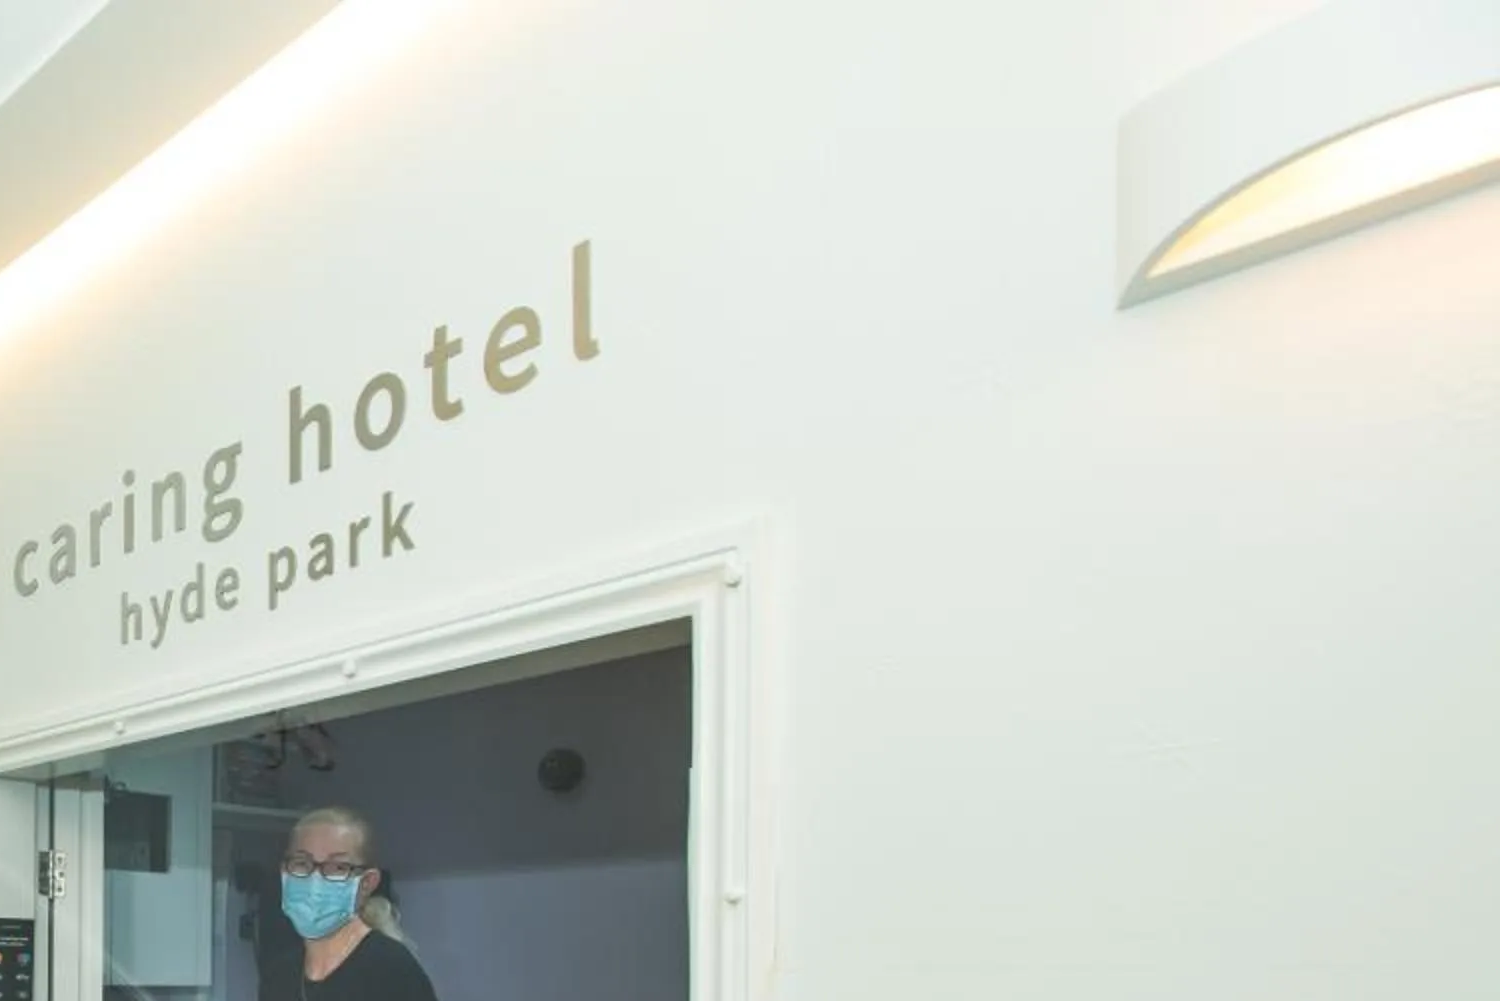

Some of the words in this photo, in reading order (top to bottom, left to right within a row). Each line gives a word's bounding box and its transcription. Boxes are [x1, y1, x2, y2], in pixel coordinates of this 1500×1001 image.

[12, 441, 243, 597] caring
[288, 240, 599, 484] hotel
[121, 562, 240, 649] hyde
[268, 491, 416, 611] park
